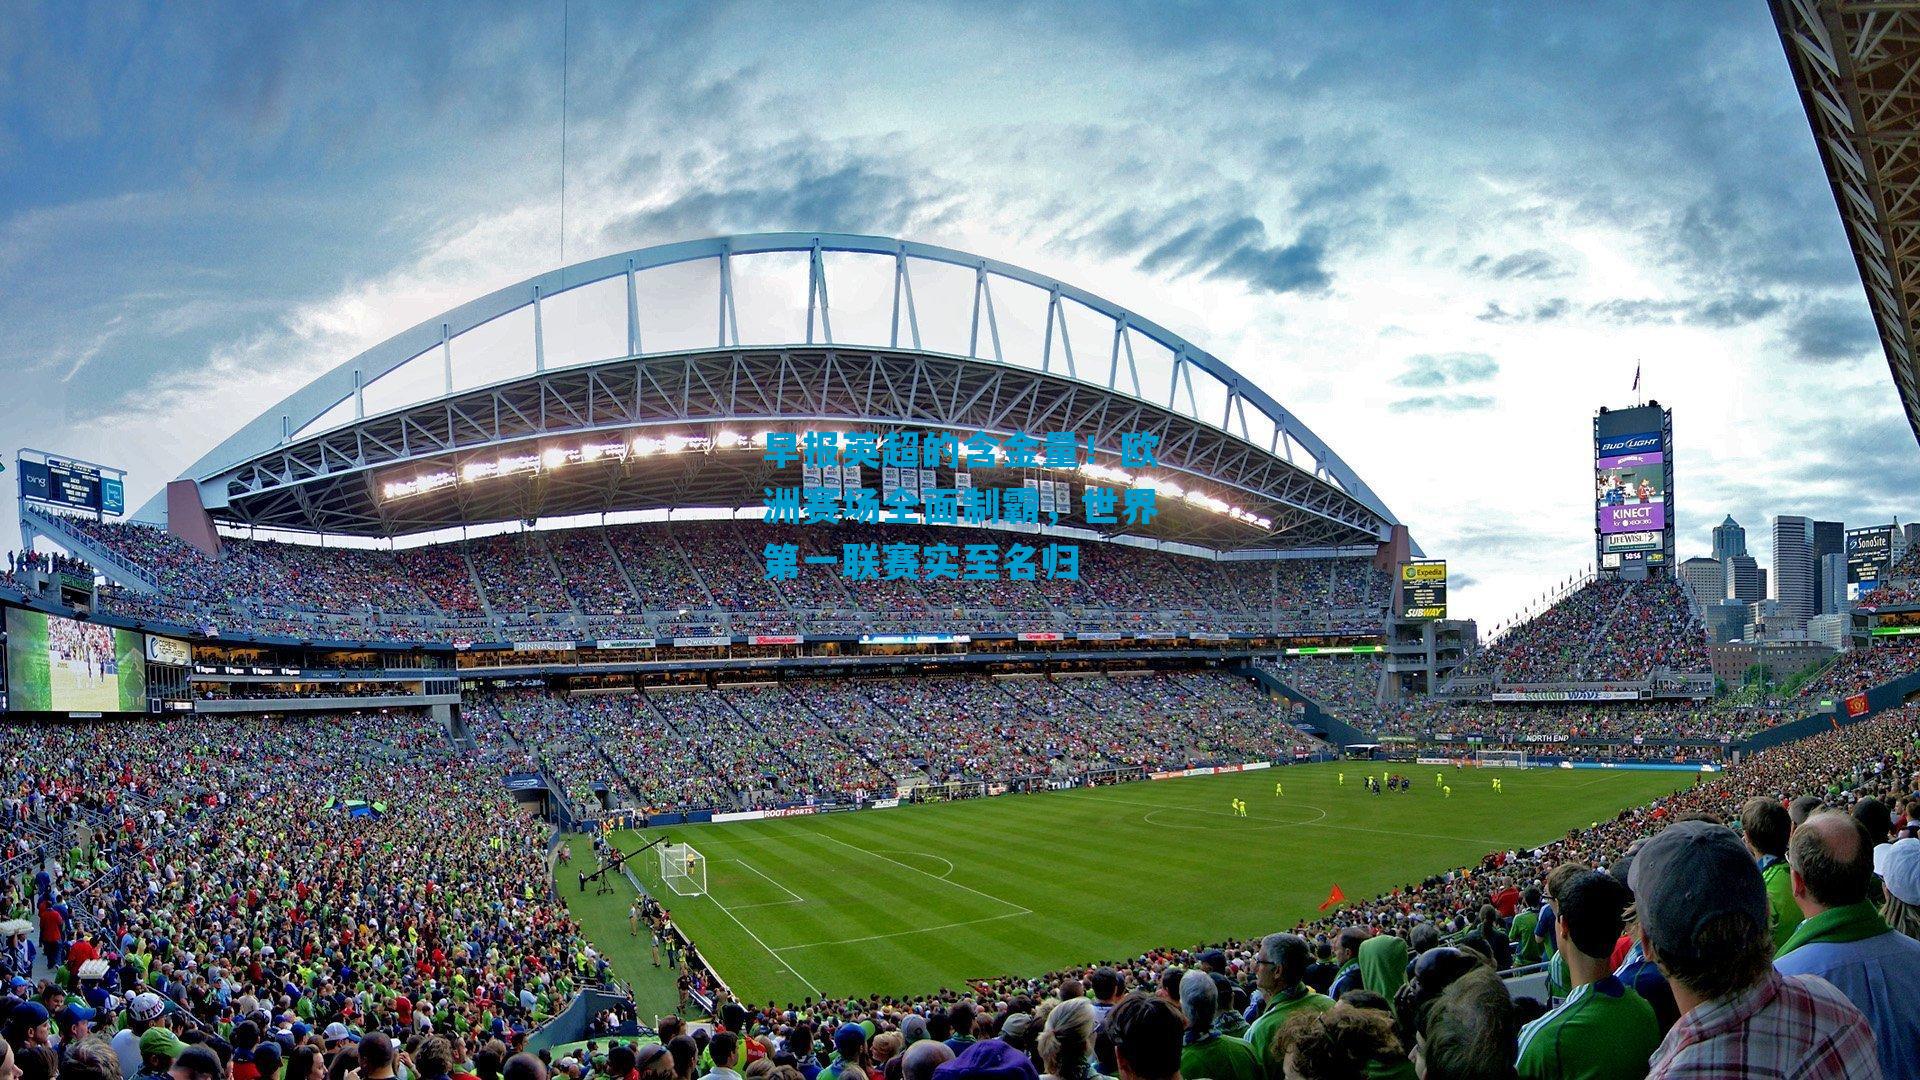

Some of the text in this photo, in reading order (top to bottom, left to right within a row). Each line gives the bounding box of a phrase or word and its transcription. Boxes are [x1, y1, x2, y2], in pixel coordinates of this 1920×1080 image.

[1628, 438, 1658, 447] LIGHT
[26, 474, 47, 487] bing
[1613, 507, 1652, 519] KINECT
[1858, 535, 1887, 549] SonoSite
[1416, 567, 1442, 577] Expedia
[1405, 608, 1445, 618] SUBWAY
[685, 636, 710, 646] Qwest
[1526, 734, 1569, 742] NORTH END
[764, 808, 786, 818] ROOT
[786, 806, 814, 816] SPORTS
